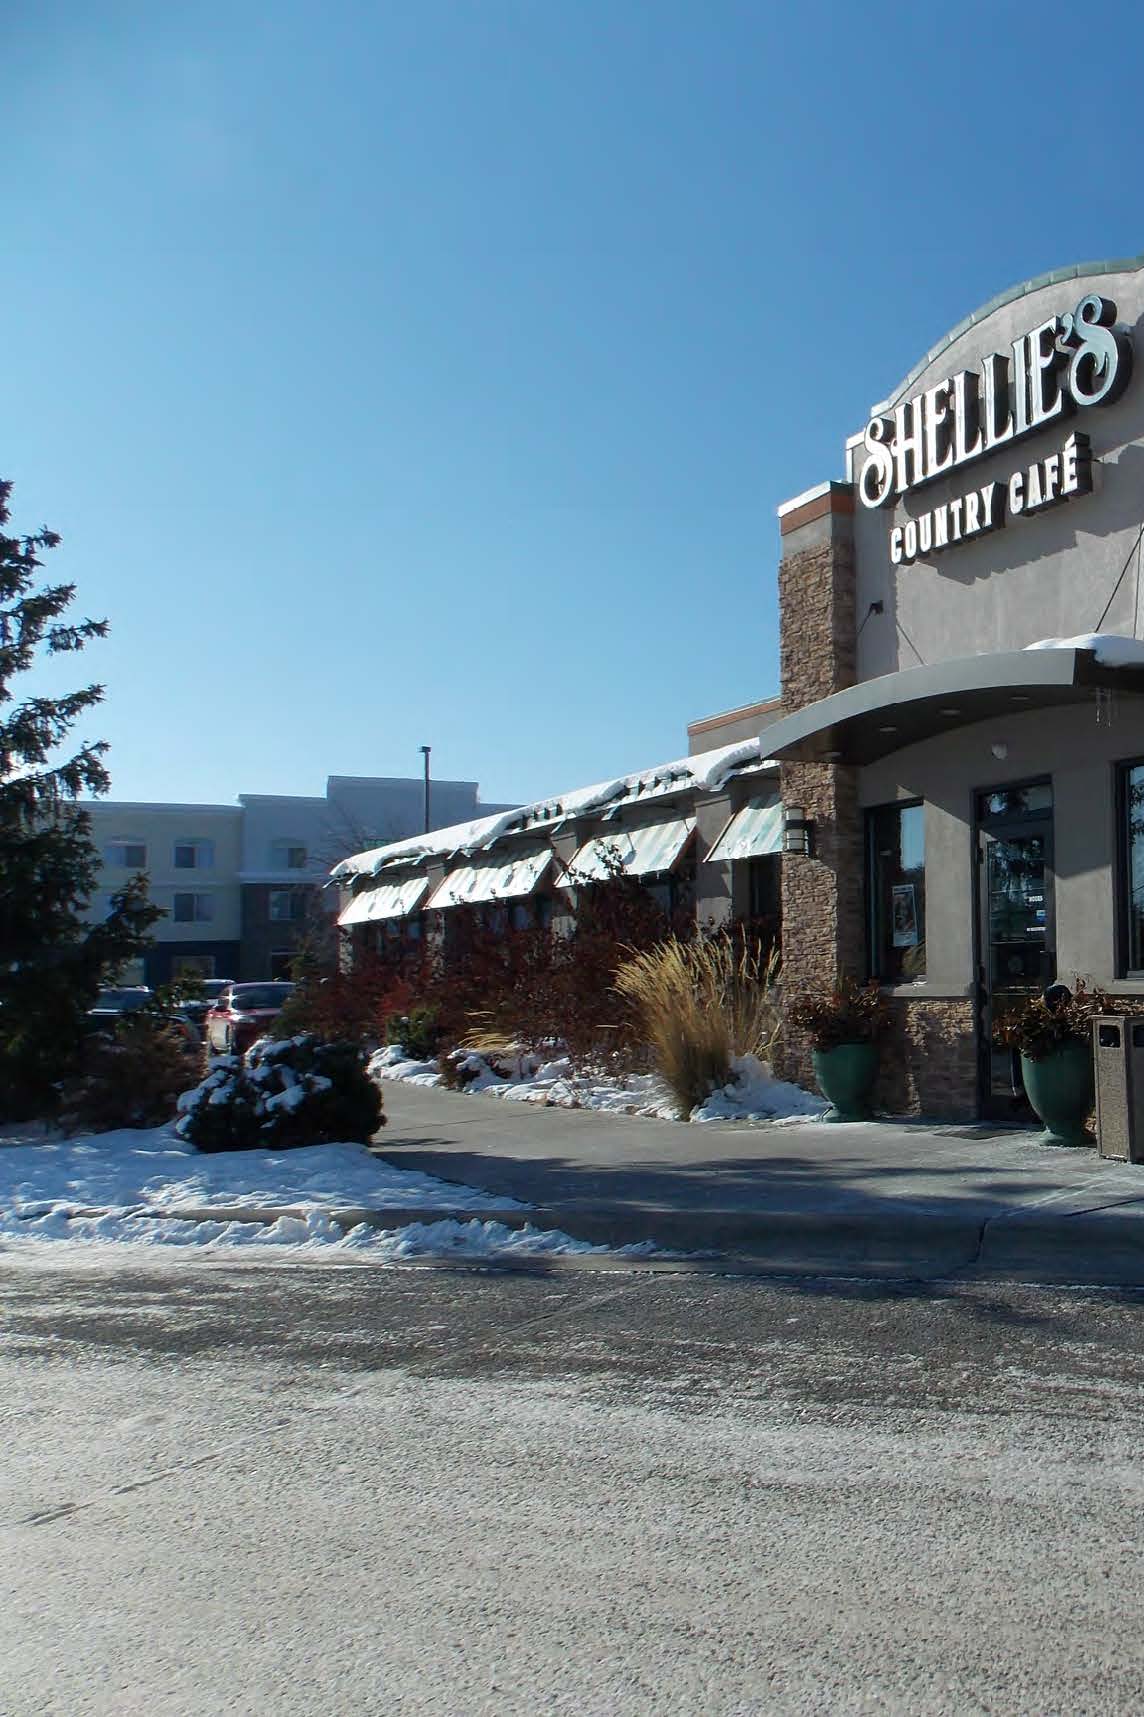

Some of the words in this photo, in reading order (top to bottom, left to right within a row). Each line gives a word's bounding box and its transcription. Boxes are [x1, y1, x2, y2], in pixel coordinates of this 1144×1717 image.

[859, 294, 1119, 509] SHELLIE'S
[889, 482, 998, 564] COUNTRY
[1009, 432, 1083, 515] CAFÉ
